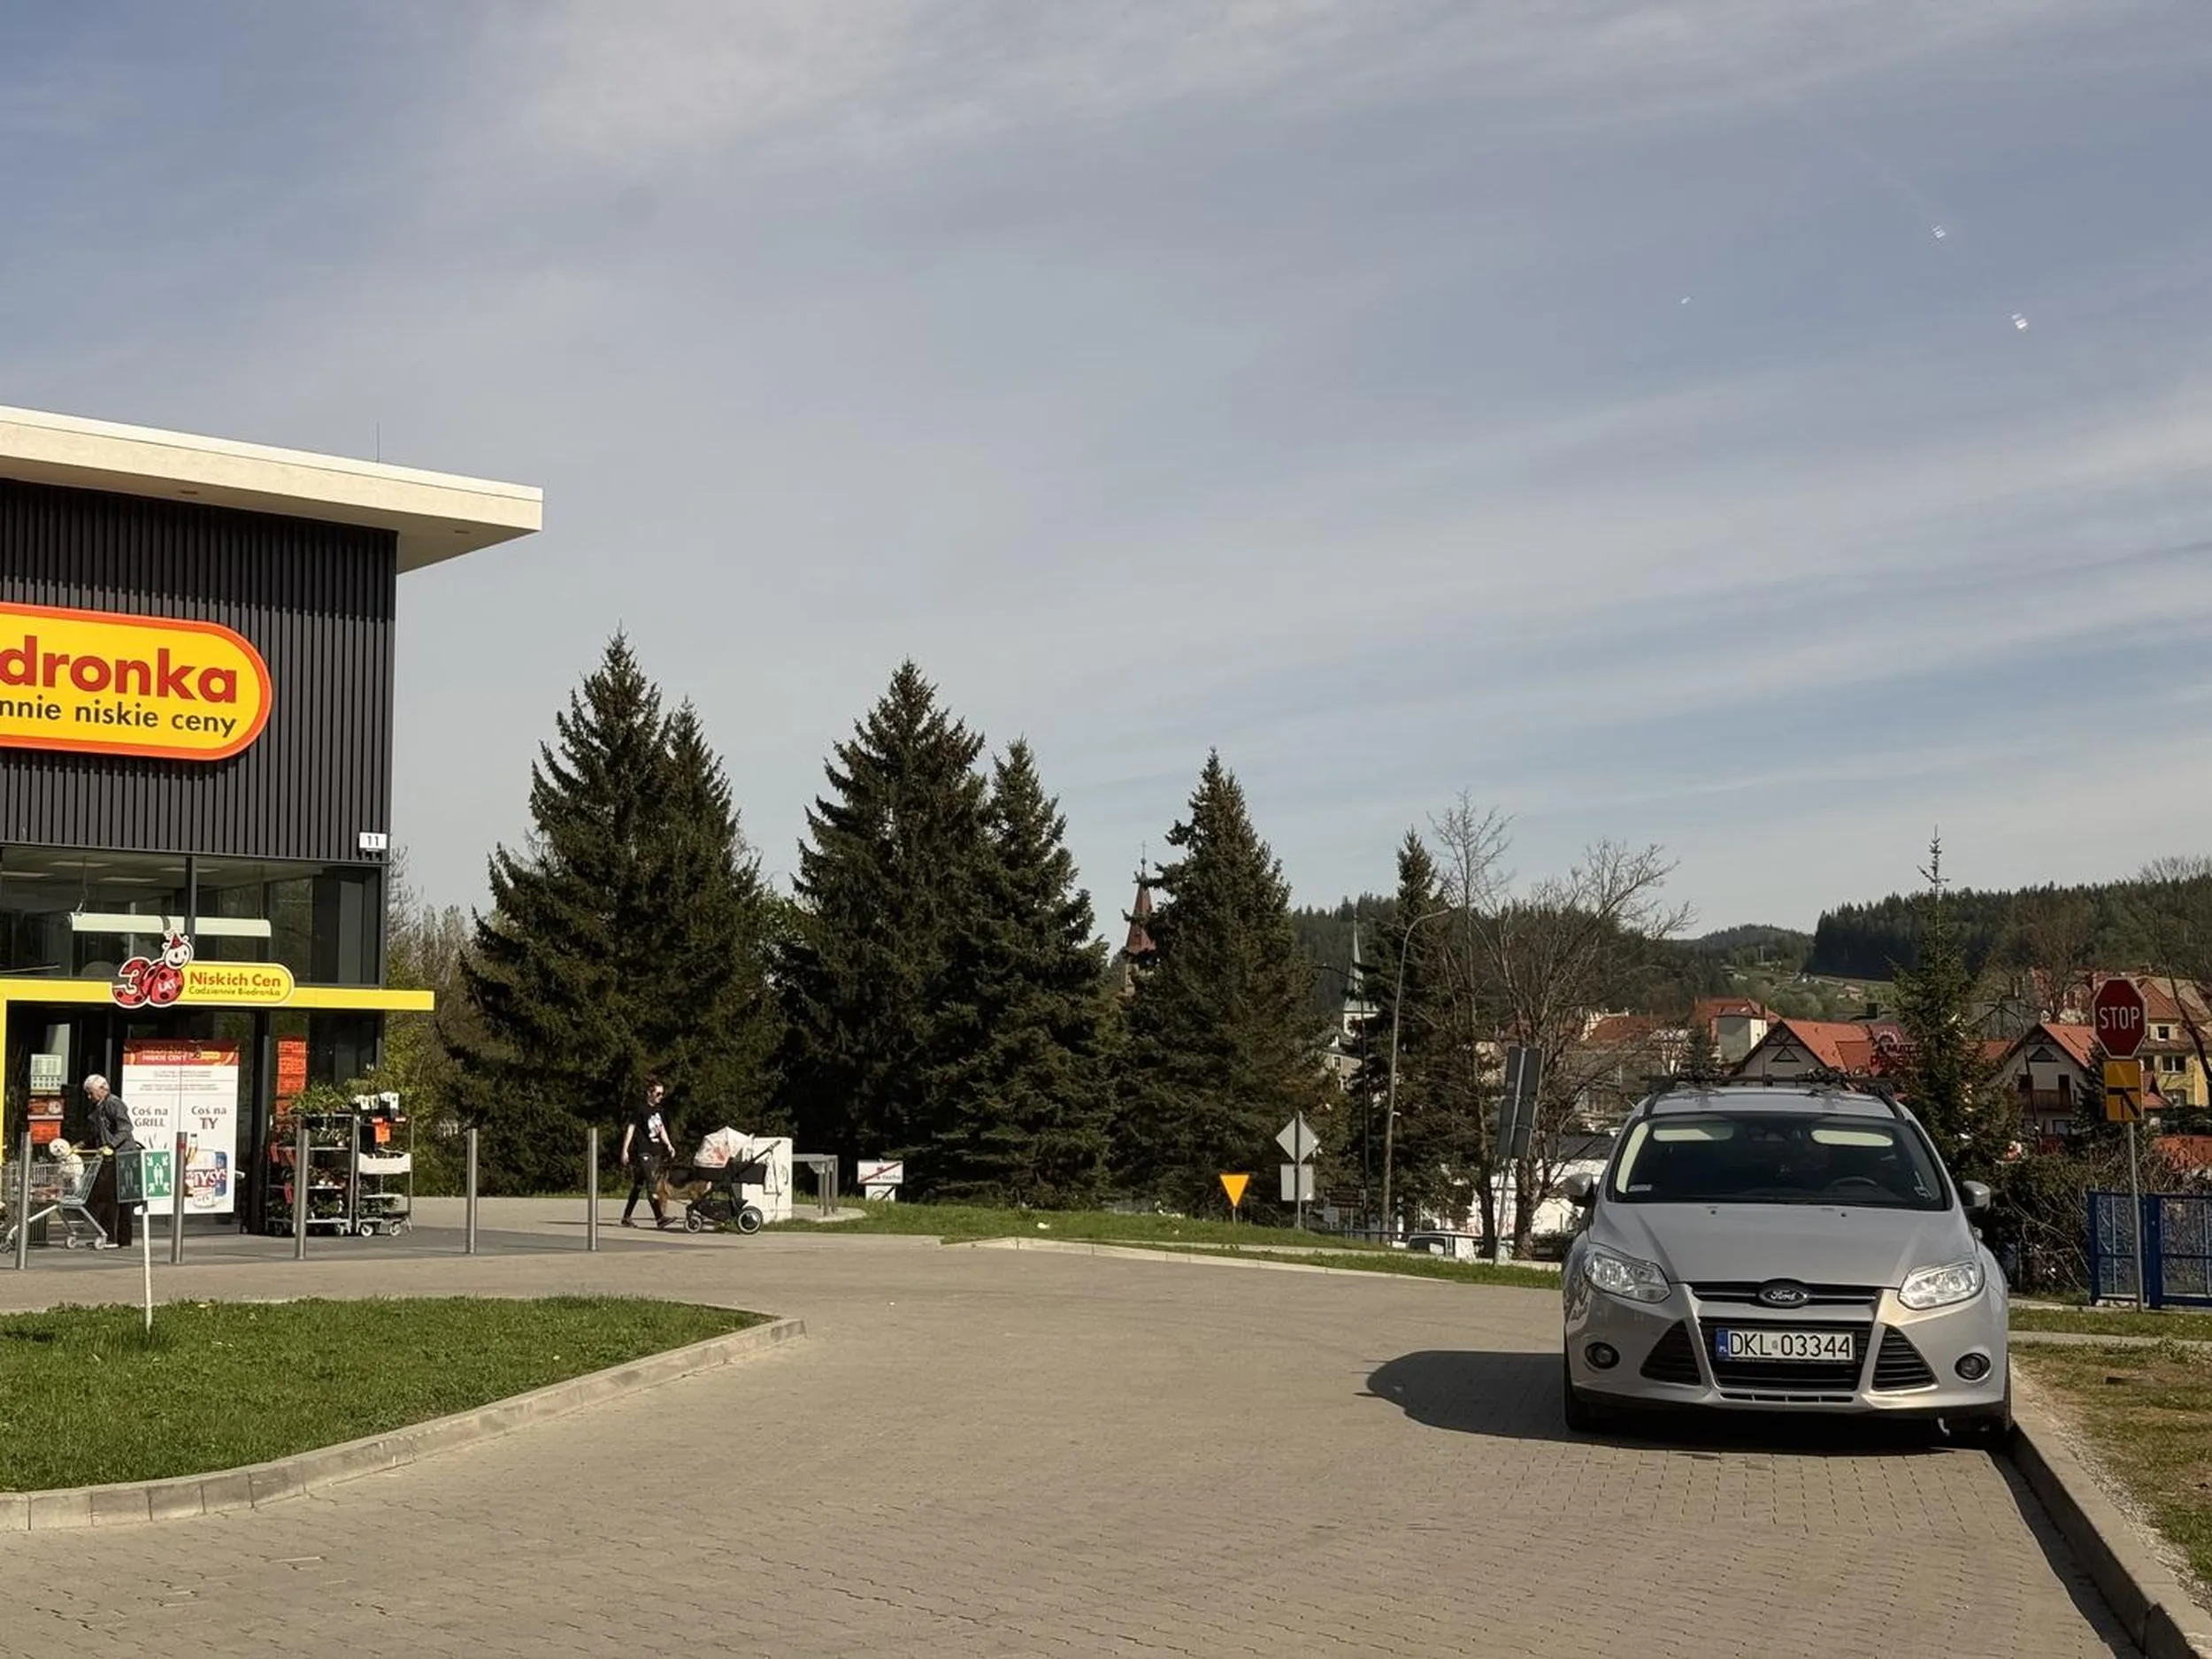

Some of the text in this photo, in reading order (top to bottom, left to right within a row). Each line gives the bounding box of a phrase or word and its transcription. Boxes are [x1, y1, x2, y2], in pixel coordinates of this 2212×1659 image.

[0, 634, 237, 703] dronka
[75, 699, 159, 728] niskie
[172, 713, 237, 738] ceny
[367, 835, 380, 847] 11
[112, 958, 185, 1007] 30
[189, 971, 281, 987] Niskich Cen
[2099, 1005, 2140, 1031] STOP
[131, 1105, 169, 1117] Coś na
[191, 1104, 227, 1116] Coś na
[134, 1117, 166, 1127] GRILL
[199, 1117, 219, 1130] TY
[1770, 1288, 1798, 1301] Ford
[1729, 1332, 1851, 1358] DKL 03344
